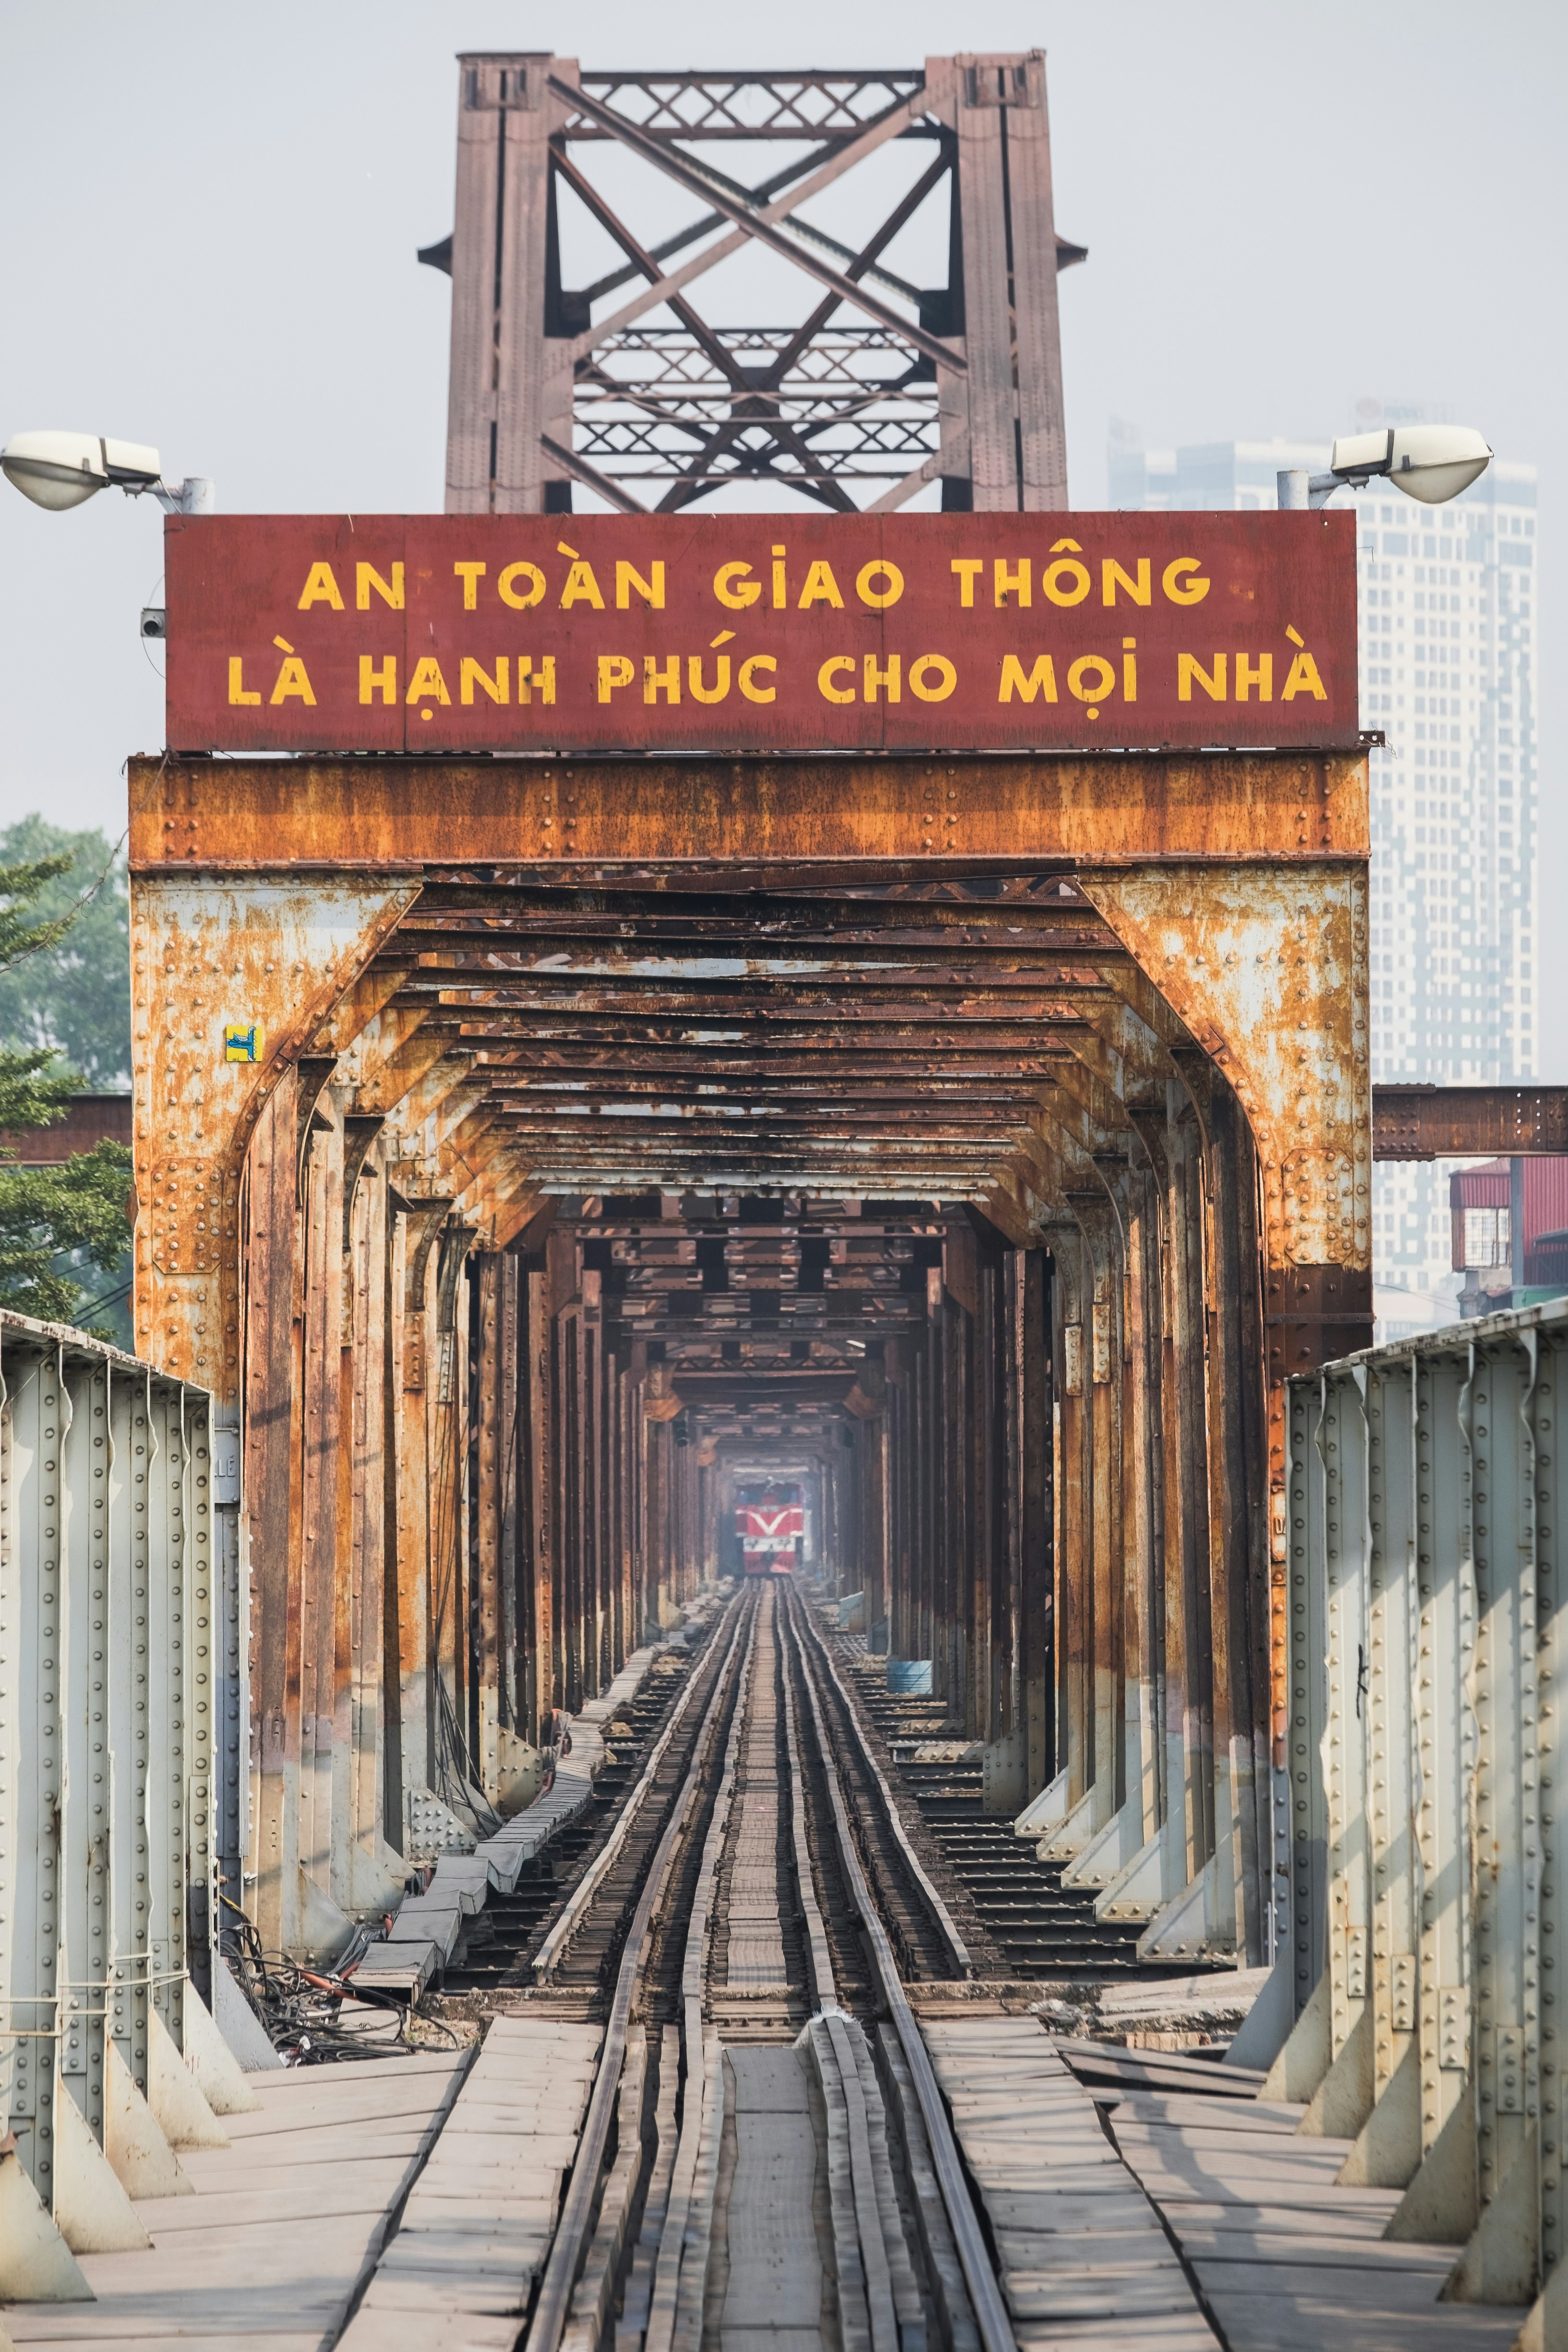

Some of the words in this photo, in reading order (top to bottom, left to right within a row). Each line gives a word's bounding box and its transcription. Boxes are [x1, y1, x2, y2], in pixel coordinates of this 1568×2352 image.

[297, 561, 405, 610] AN
[454, 541, 665, 610] TOÀN
[951, 538, 1211, 608] THÔNG
[228, 635, 317, 706] LÀ
[359, 655, 556, 721] HẠNH
[598, 630, 777, 705] PHÚC
[817, 654, 957, 704] CHO
[1178, 624, 1328, 702] NHÀ
